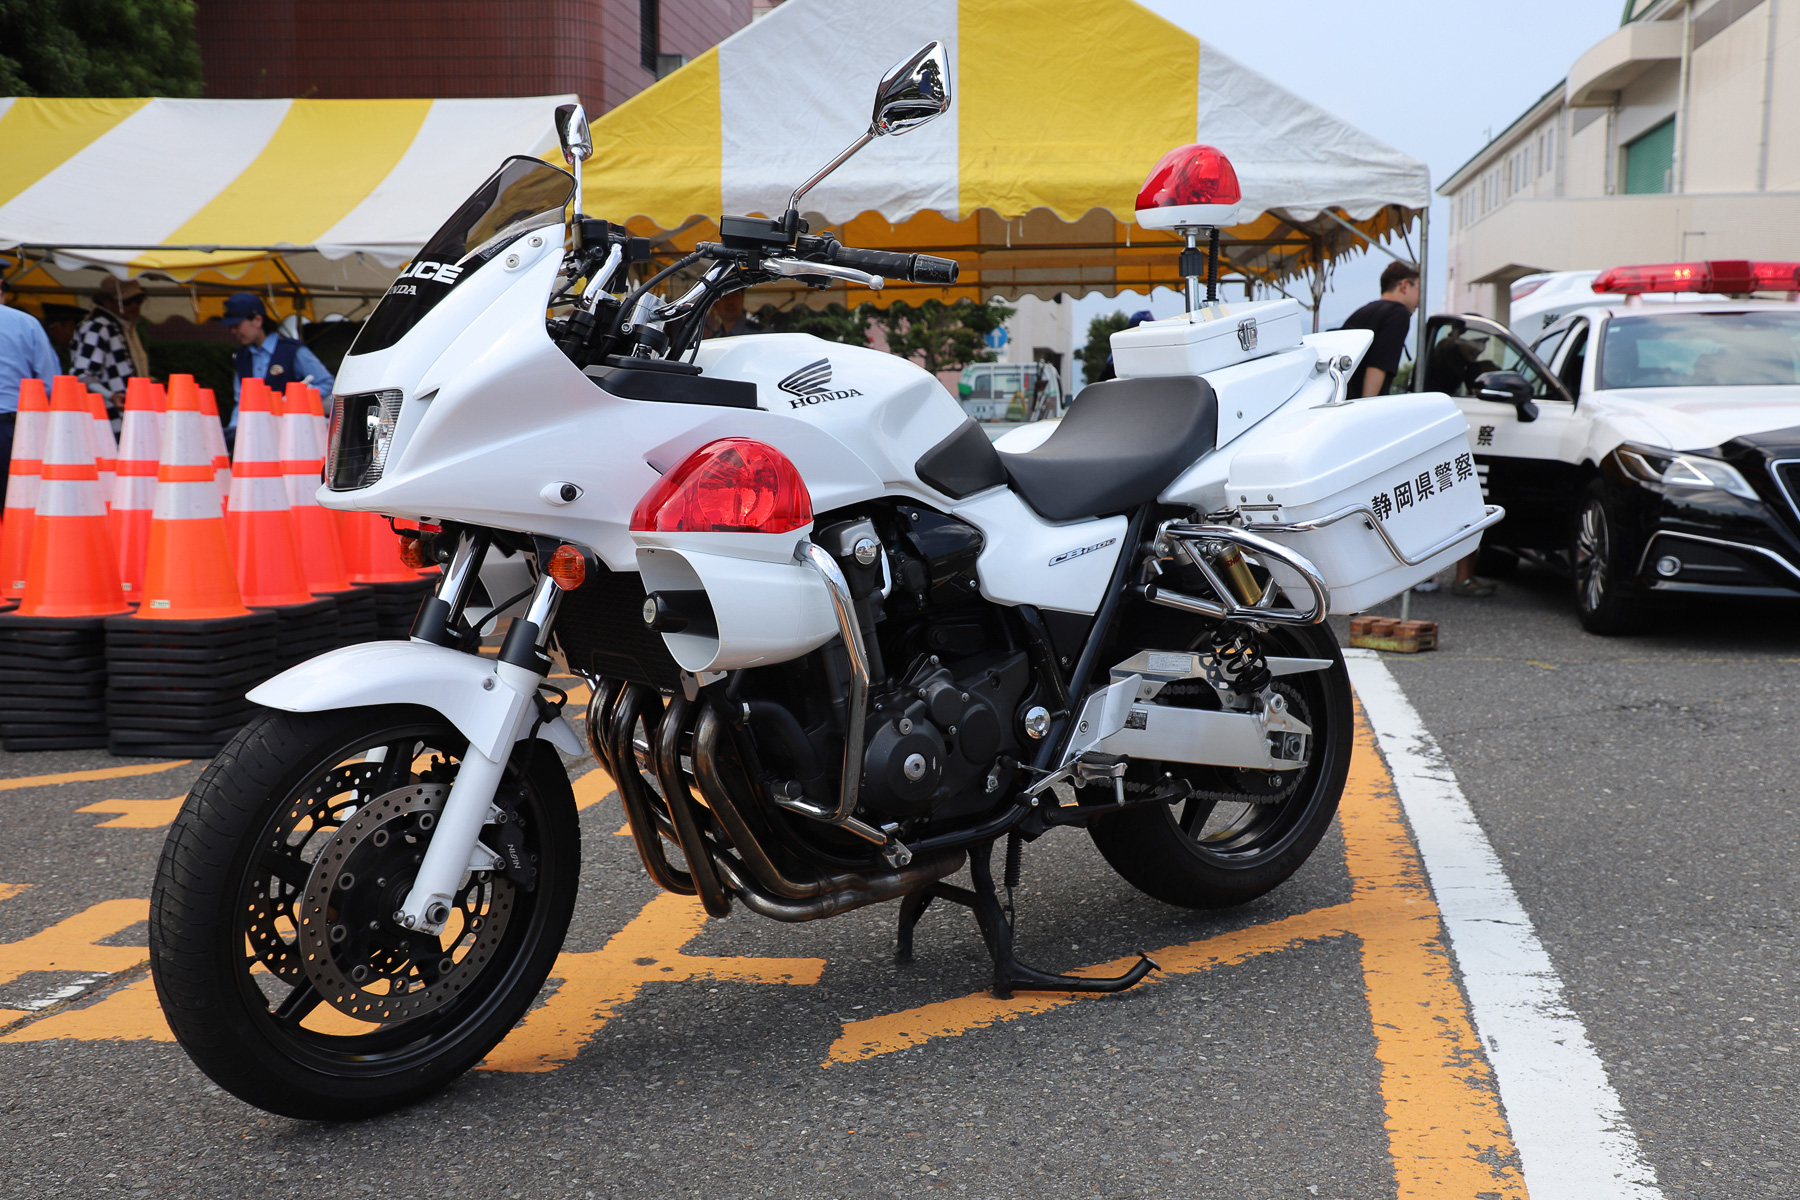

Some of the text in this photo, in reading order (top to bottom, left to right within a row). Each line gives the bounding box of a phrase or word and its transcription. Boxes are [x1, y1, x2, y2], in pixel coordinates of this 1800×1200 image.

[788, 388, 864, 410] HONDA
[1371, 452, 1474, 522] 静岡県警察
